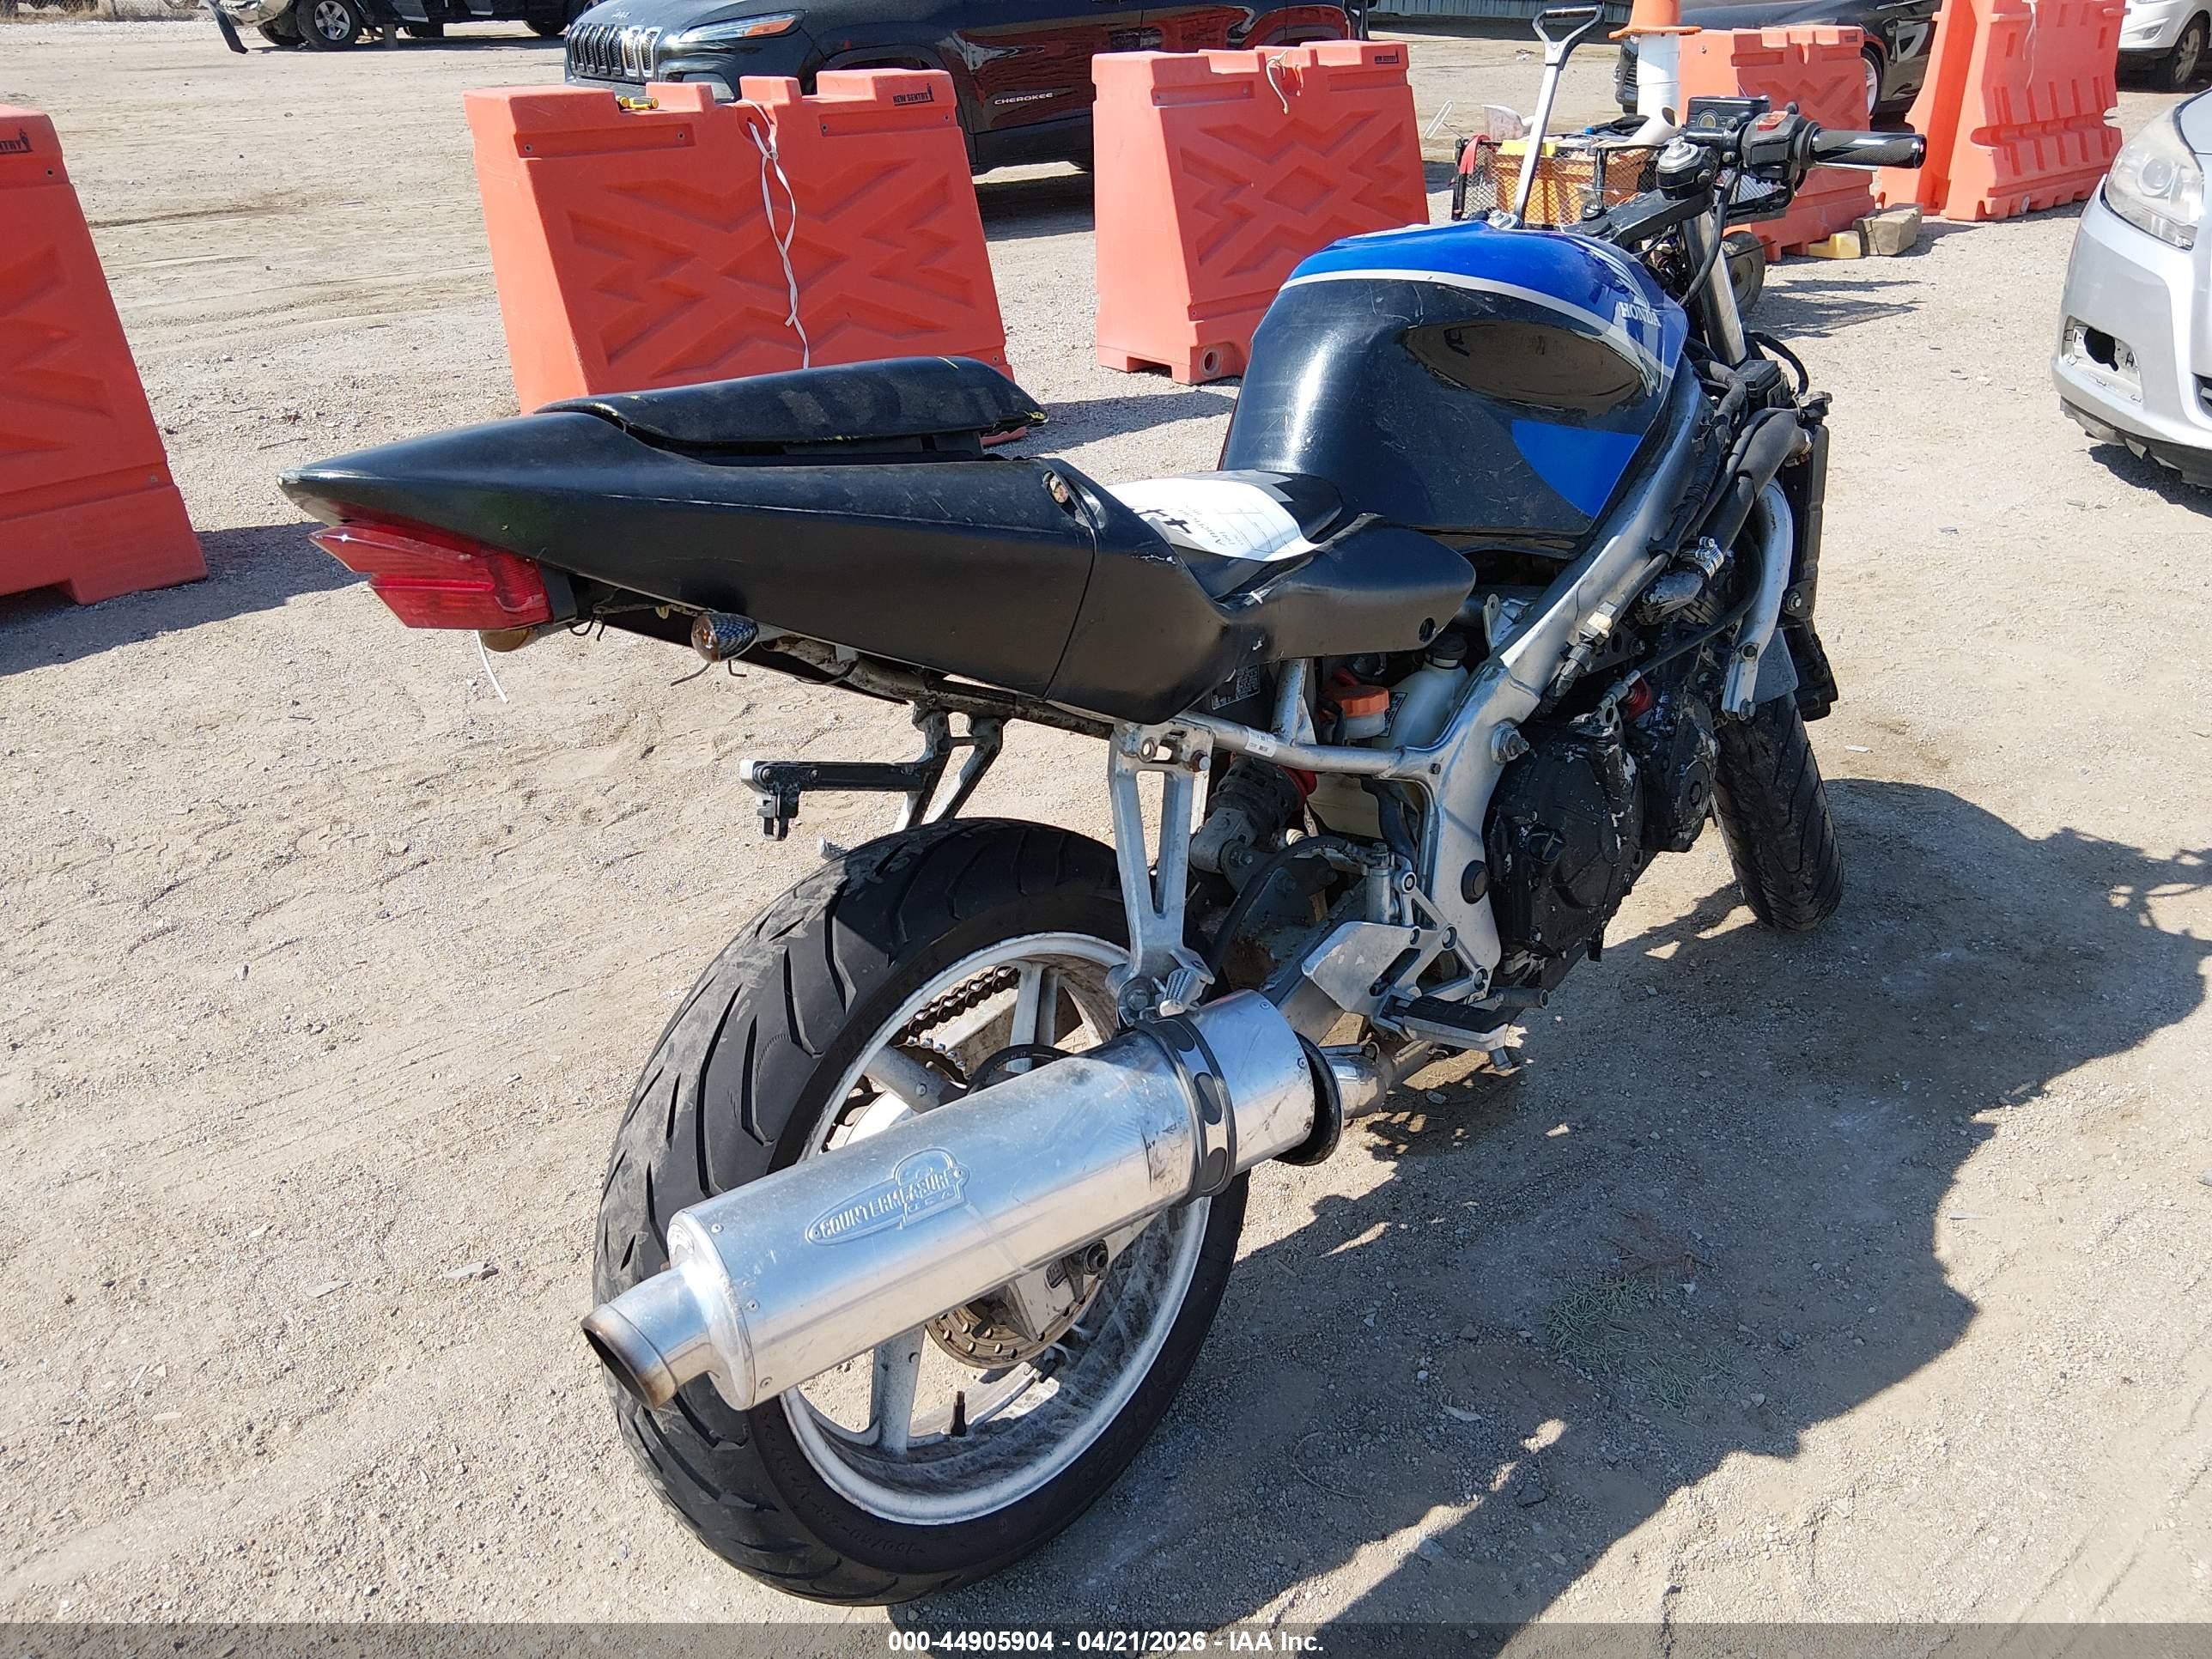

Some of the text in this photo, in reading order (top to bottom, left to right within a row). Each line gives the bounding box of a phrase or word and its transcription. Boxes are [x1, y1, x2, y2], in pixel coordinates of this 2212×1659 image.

[893, 91, 929, 104] NEW SENTRY
[994, 92, 1054, 105] CHEROKEE
[1616, 301, 1662, 327] HONDA
[818, 1168, 956, 1238] COUNTERMEASURE
